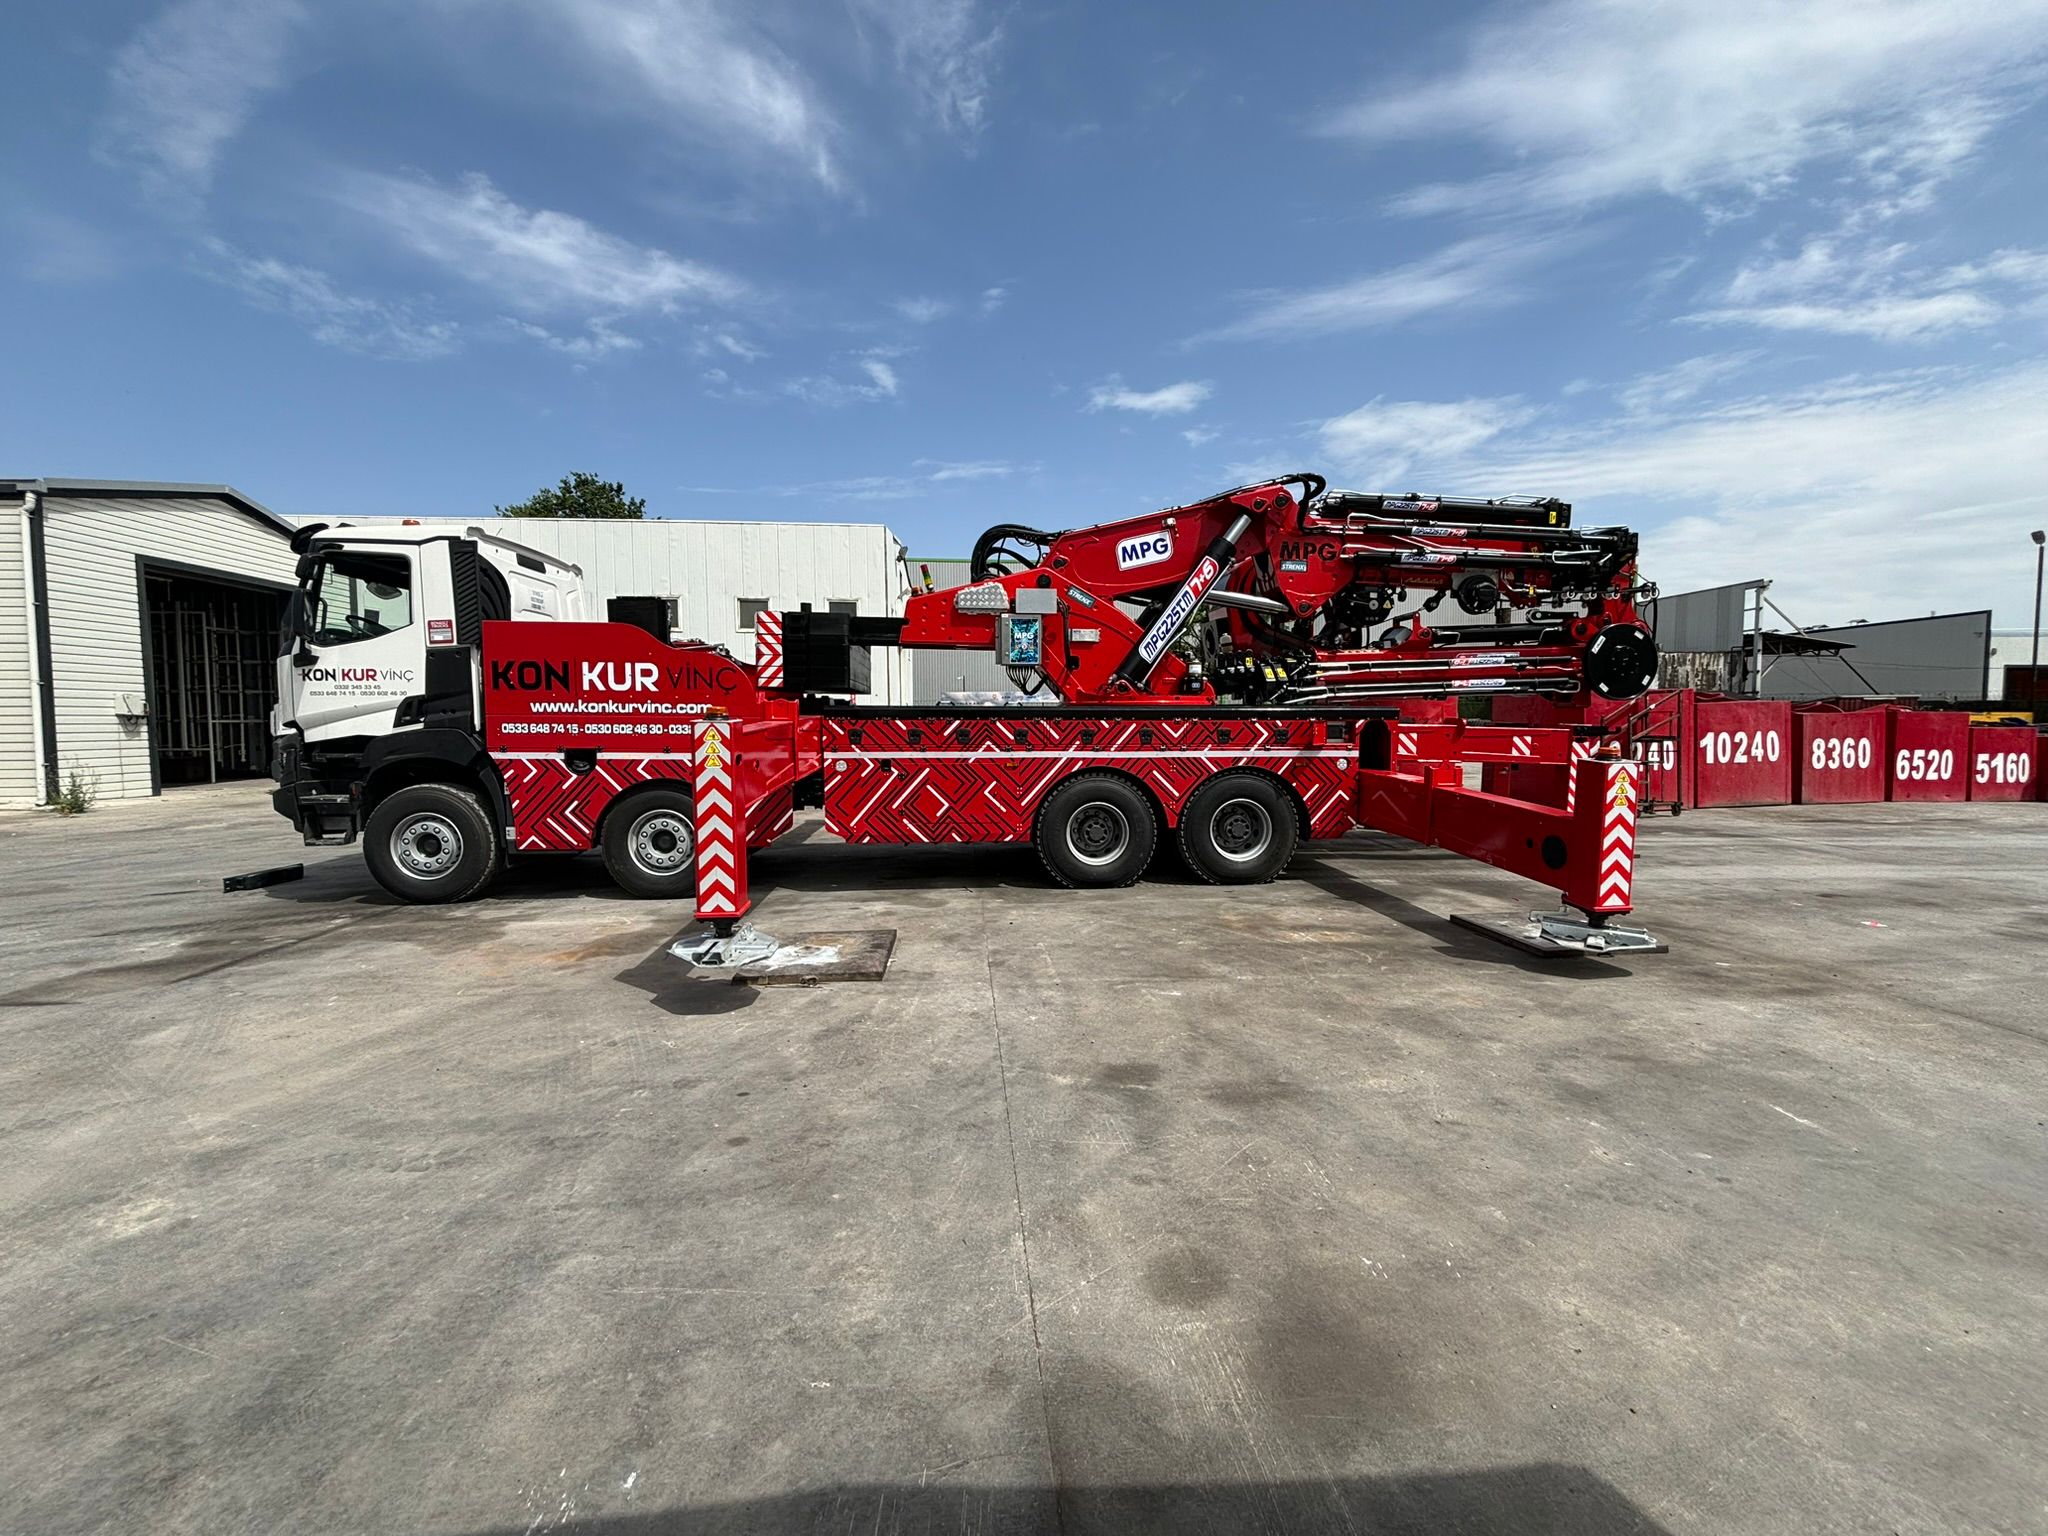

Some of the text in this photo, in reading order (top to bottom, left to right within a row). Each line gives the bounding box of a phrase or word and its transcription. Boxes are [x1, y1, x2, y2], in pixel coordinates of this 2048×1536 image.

[1121, 537, 1169, 563] MPG
[1279, 541, 1338, 562] MPG
[1068, 588, 1091, 606] STRENX
[1143, 559, 1214, 659] MPG225TM 7+6
[1013, 631, 1035, 640] MPG
[301, 667, 414, 683] KON KUR VİNÇ
[491, 659, 737, 695] KON KUR VİNÇ
[530, 699, 713, 714] www.konkurvinc.com
[501, 723, 529, 734] 0533
[530, 723, 550, 734] 648
[551, 723, 565, 734] 74
[566, 723, 579, 734] 15
[584, 723, 611, 734] 0530
[613, 723, 633, 734] 602
[634, 723, 647, 734] 46
[649, 724, 663, 734] 30
[1700, 730, 1780, 764] 10240
[1811, 737, 1871, 770] 8360
[1896, 749, 1954, 781] 6520
[1975, 752, 2030, 784] 5160
